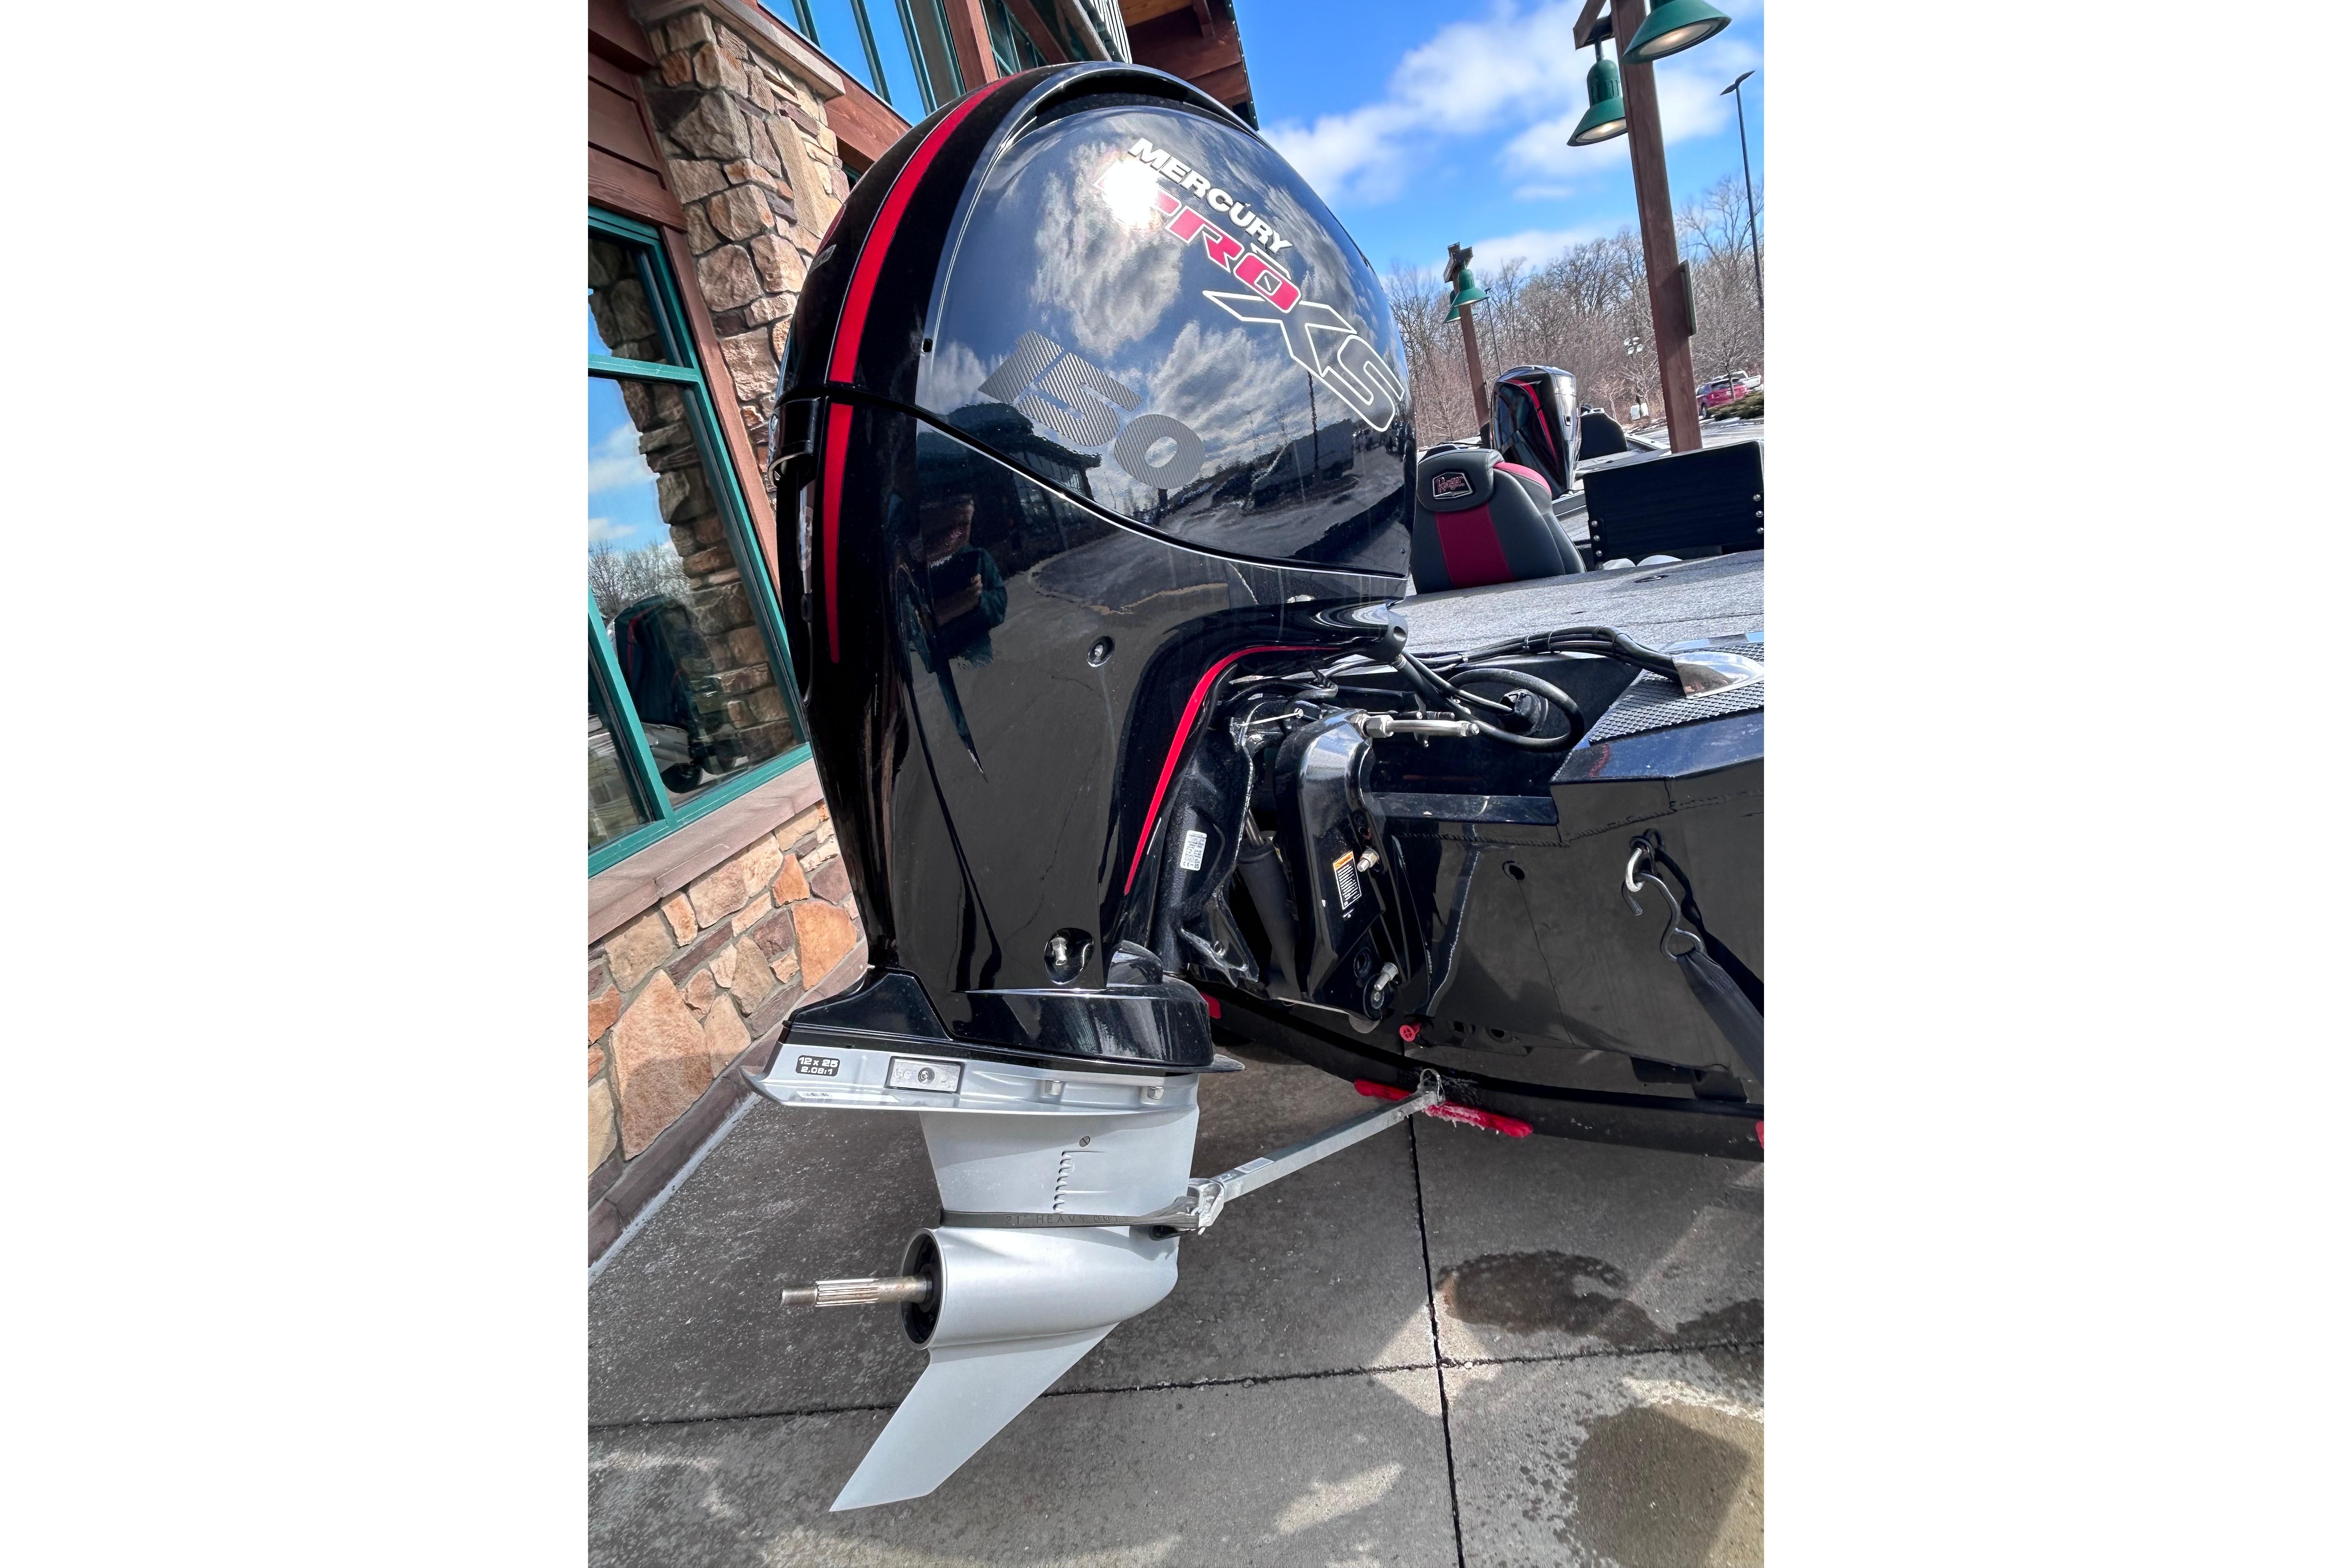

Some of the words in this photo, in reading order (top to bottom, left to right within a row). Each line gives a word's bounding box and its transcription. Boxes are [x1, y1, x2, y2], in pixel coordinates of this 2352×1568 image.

[1128, 138, 1292, 254] MERCURY
[1202, 242, 1405, 432] XS
[978, 330, 1206, 489] 150
[801, 1066, 833, 1074] 2.08:1
[821, 1059, 838, 1068] 25
[1036, 1214, 1086, 1224] HEAVY
